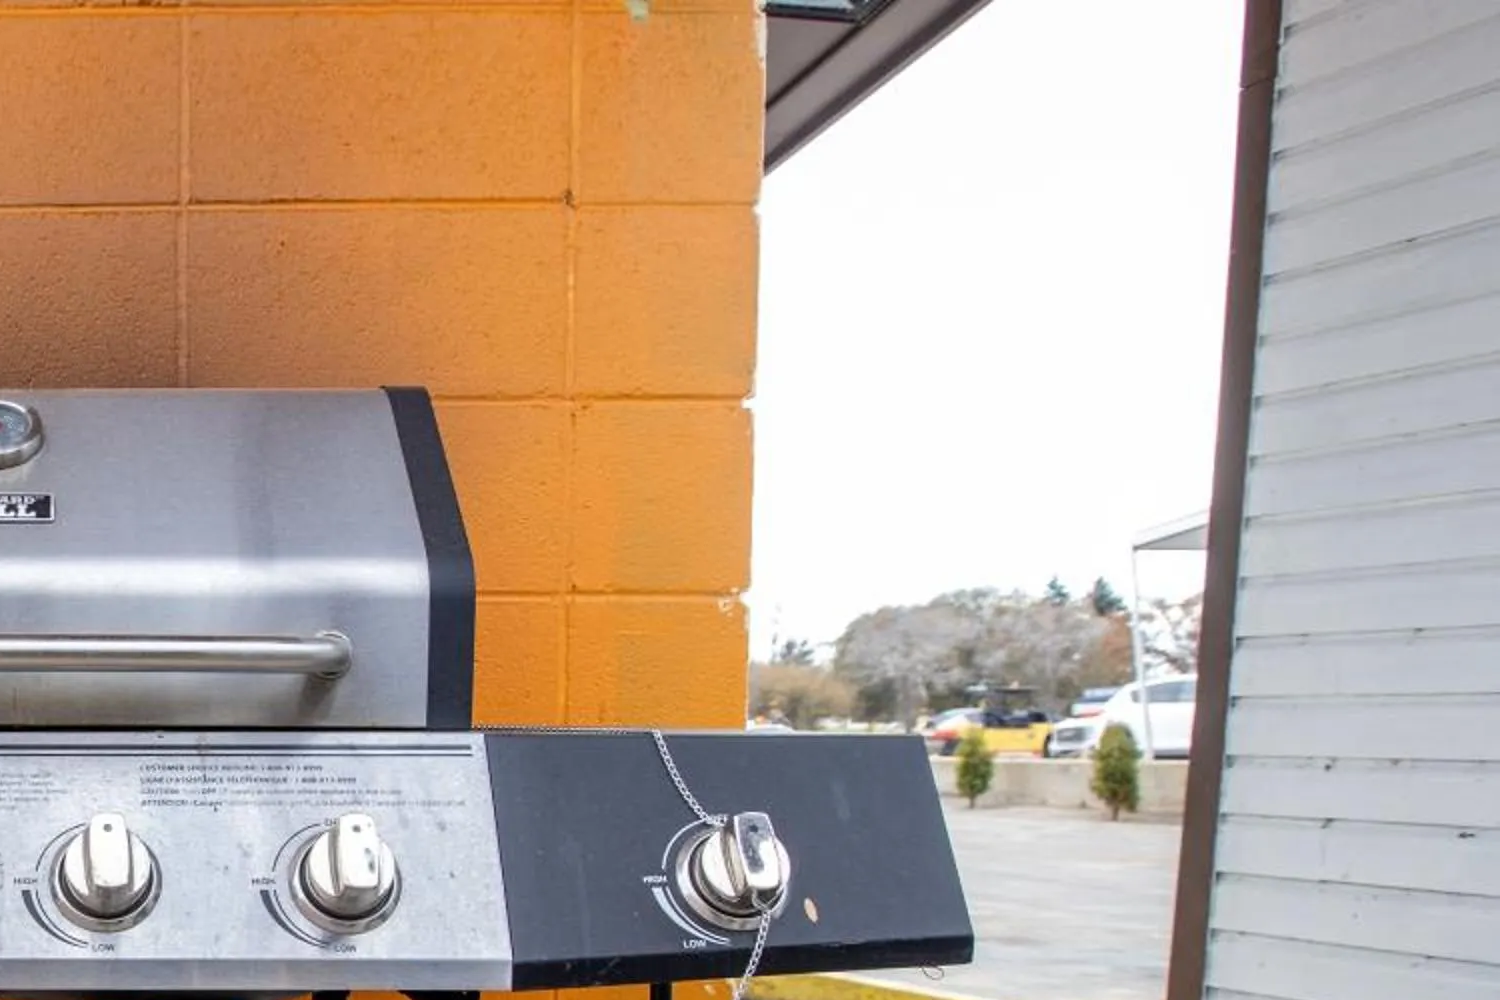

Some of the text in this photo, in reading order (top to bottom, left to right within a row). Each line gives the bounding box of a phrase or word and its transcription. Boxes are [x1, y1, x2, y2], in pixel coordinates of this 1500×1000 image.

[13, 877, 38, 885] HIGH
[643, 875, 668, 883] HIGH
[92, 943, 115, 952] LOW
[683, 939, 707, 948] LOW
[334, 944, 357, 952] LOW
